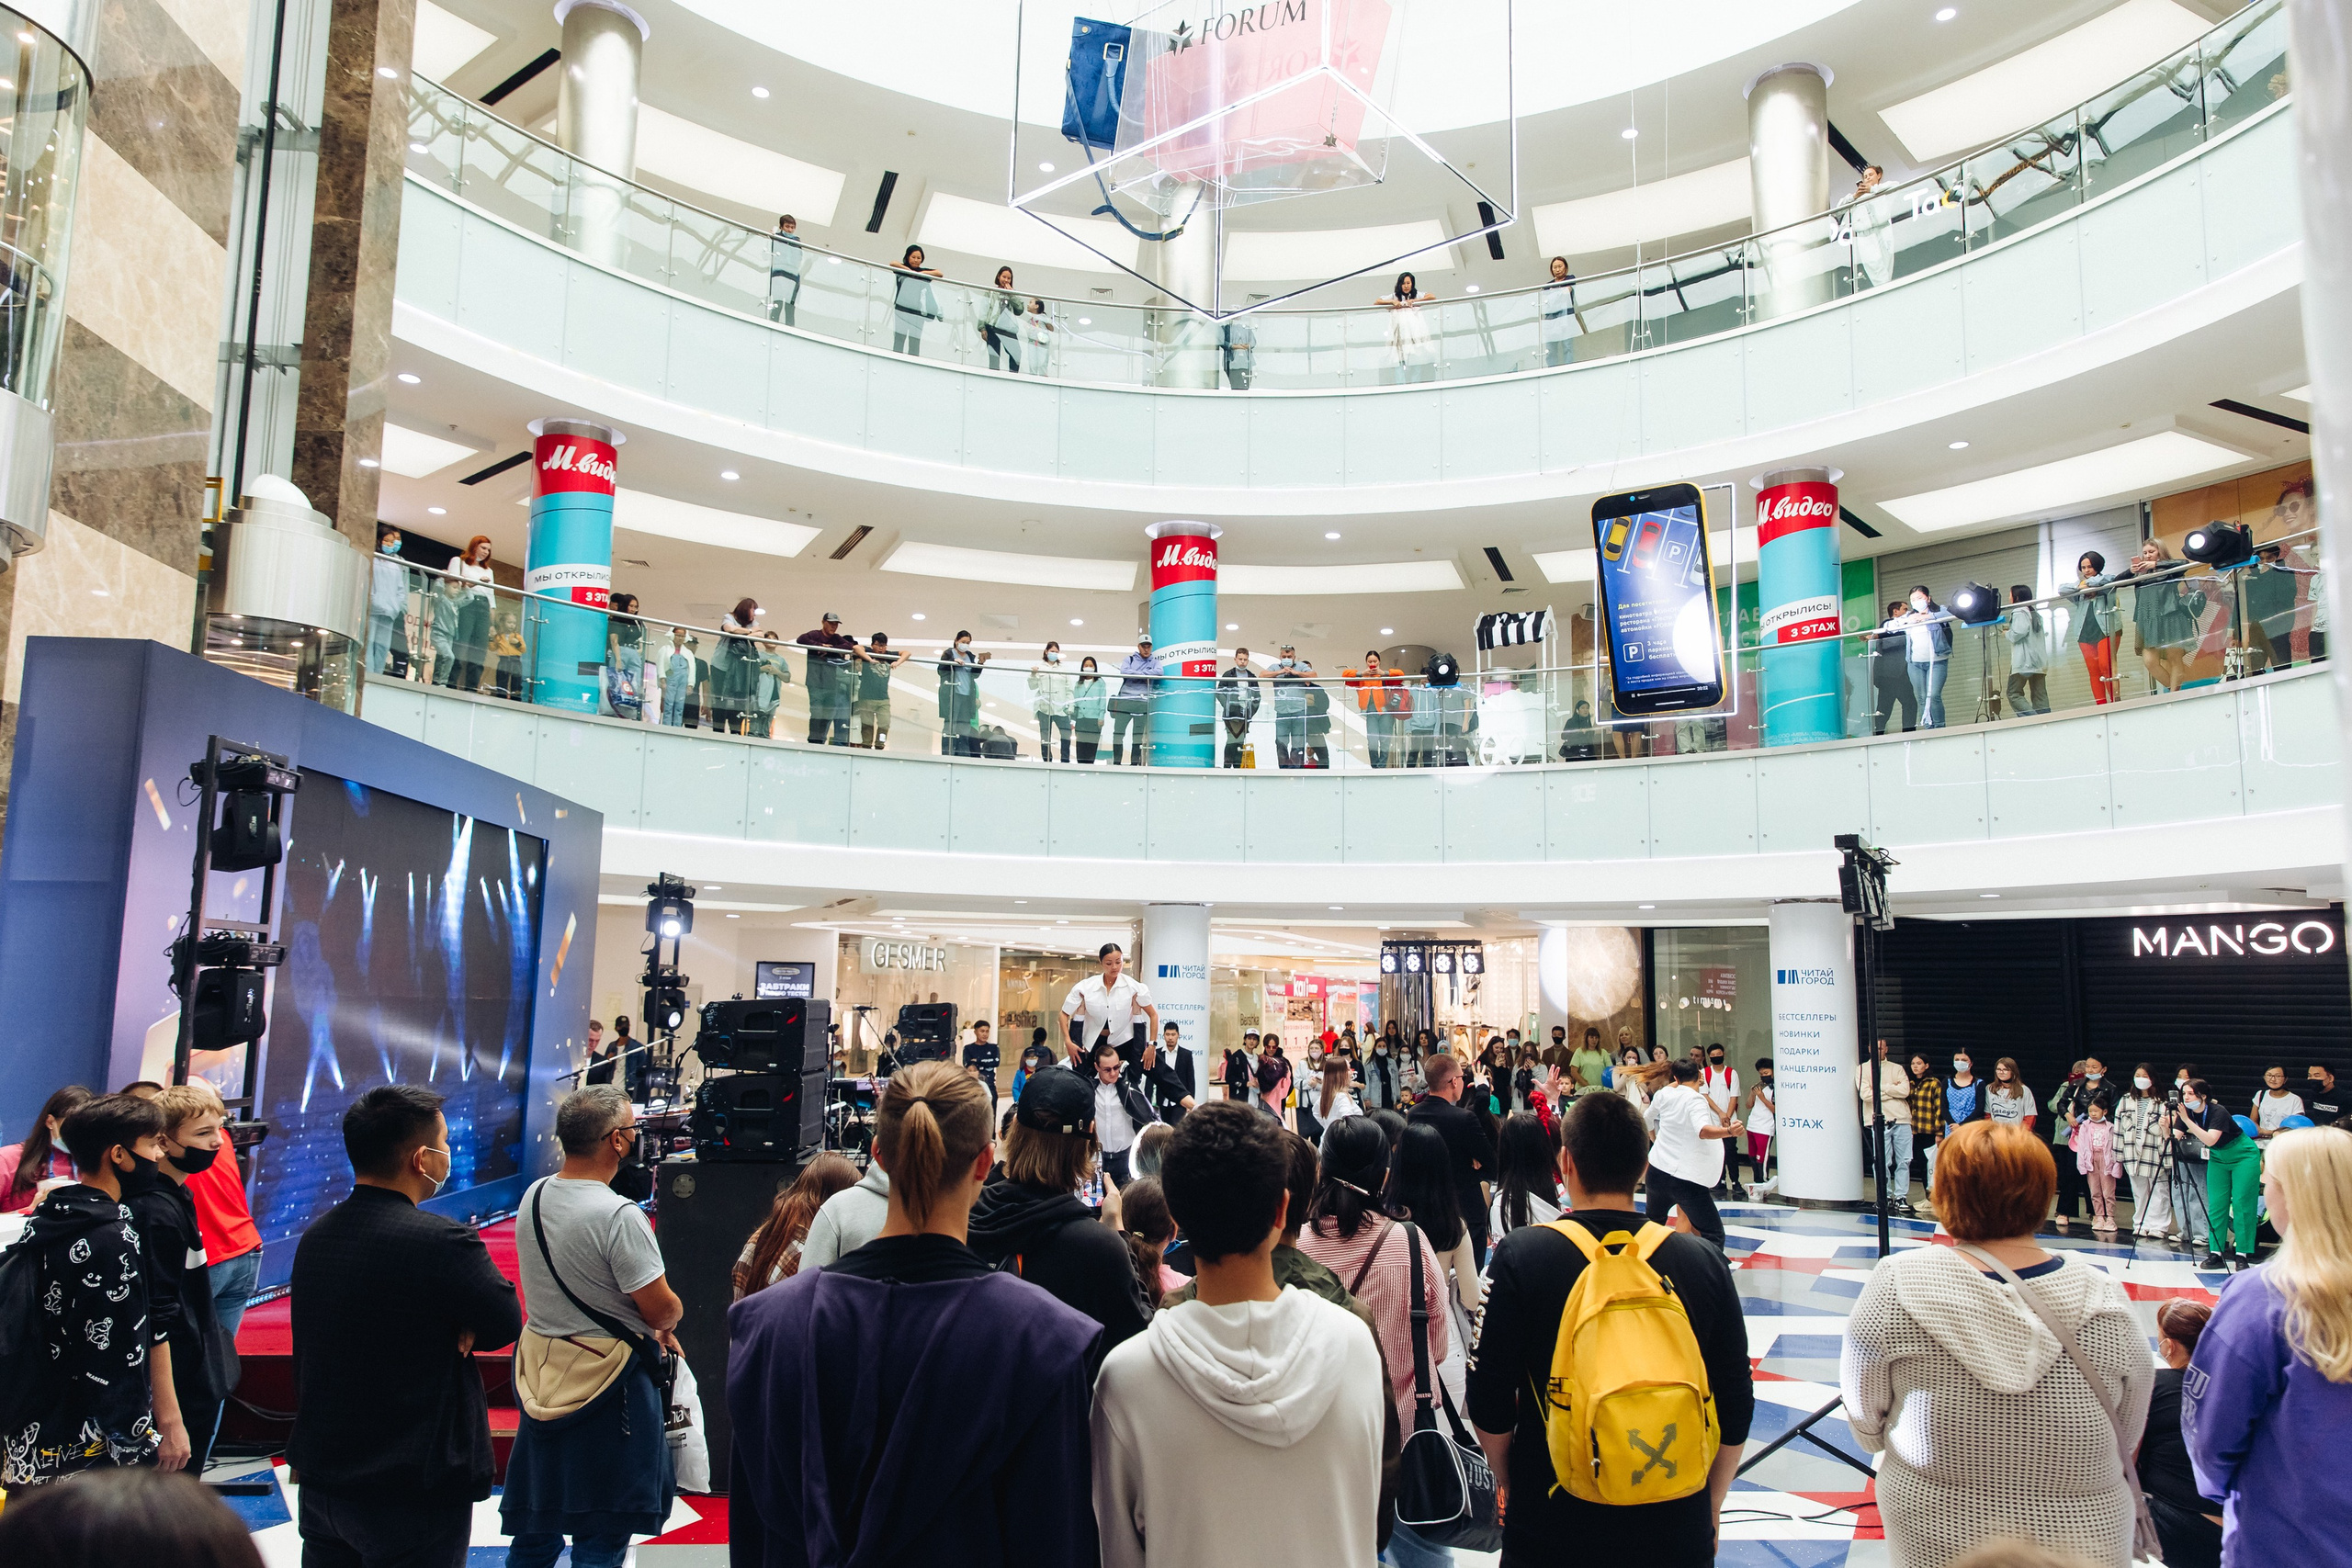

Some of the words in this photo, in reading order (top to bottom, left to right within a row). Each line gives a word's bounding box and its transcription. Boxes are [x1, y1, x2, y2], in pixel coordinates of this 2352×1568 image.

[1201, 0, 1306, 45] FORUM
[542, 445, 616, 484] М.виде
[1157, 544, 1218, 570] М.виде
[534, 573, 551, 583] МЫ
[555, 571, 611, 582] ОТКРЫЛИС
[594, 592, 609, 603] ЭТА
[1619, 611, 1652, 619] кинотеатра
[1765, 603, 1832, 626] ОТКРЫЛИСЬ!
[1620, 619, 1651, 627] ресторана
[1621, 625, 1652, 633] автомойки
[1801, 621, 1837, 635] ЭТАЖ
[1169, 647, 1217, 658] ОТКРЫЛИСЬ
[1201, 664, 1216, 672] ЭТА
[2132, 921, 2335, 957] MANGO
[872, 942, 945, 972] GESMER
[1801, 967, 1834, 976] ЧИТАЙ
[1801, 977, 1835, 986] ГОРОД
[760, 983, 810, 991] ЗАВТРАКИ
[1779, 1013, 1837, 1021] БЕСТСЕЛЛЕРЫ
[1779, 1030, 1820, 1038] НОВИНКИ
[1780, 1047, 1820, 1055] ПОДАРКИ
[1780, 1065, 1837, 1074] КАНЦЕЛЯРИЯ
[1781, 1081, 1807, 1090] КНИГИ
[1781, 1118, 1787, 1128] 3
[1788, 1118, 1824, 1130] ЭТАЖ
